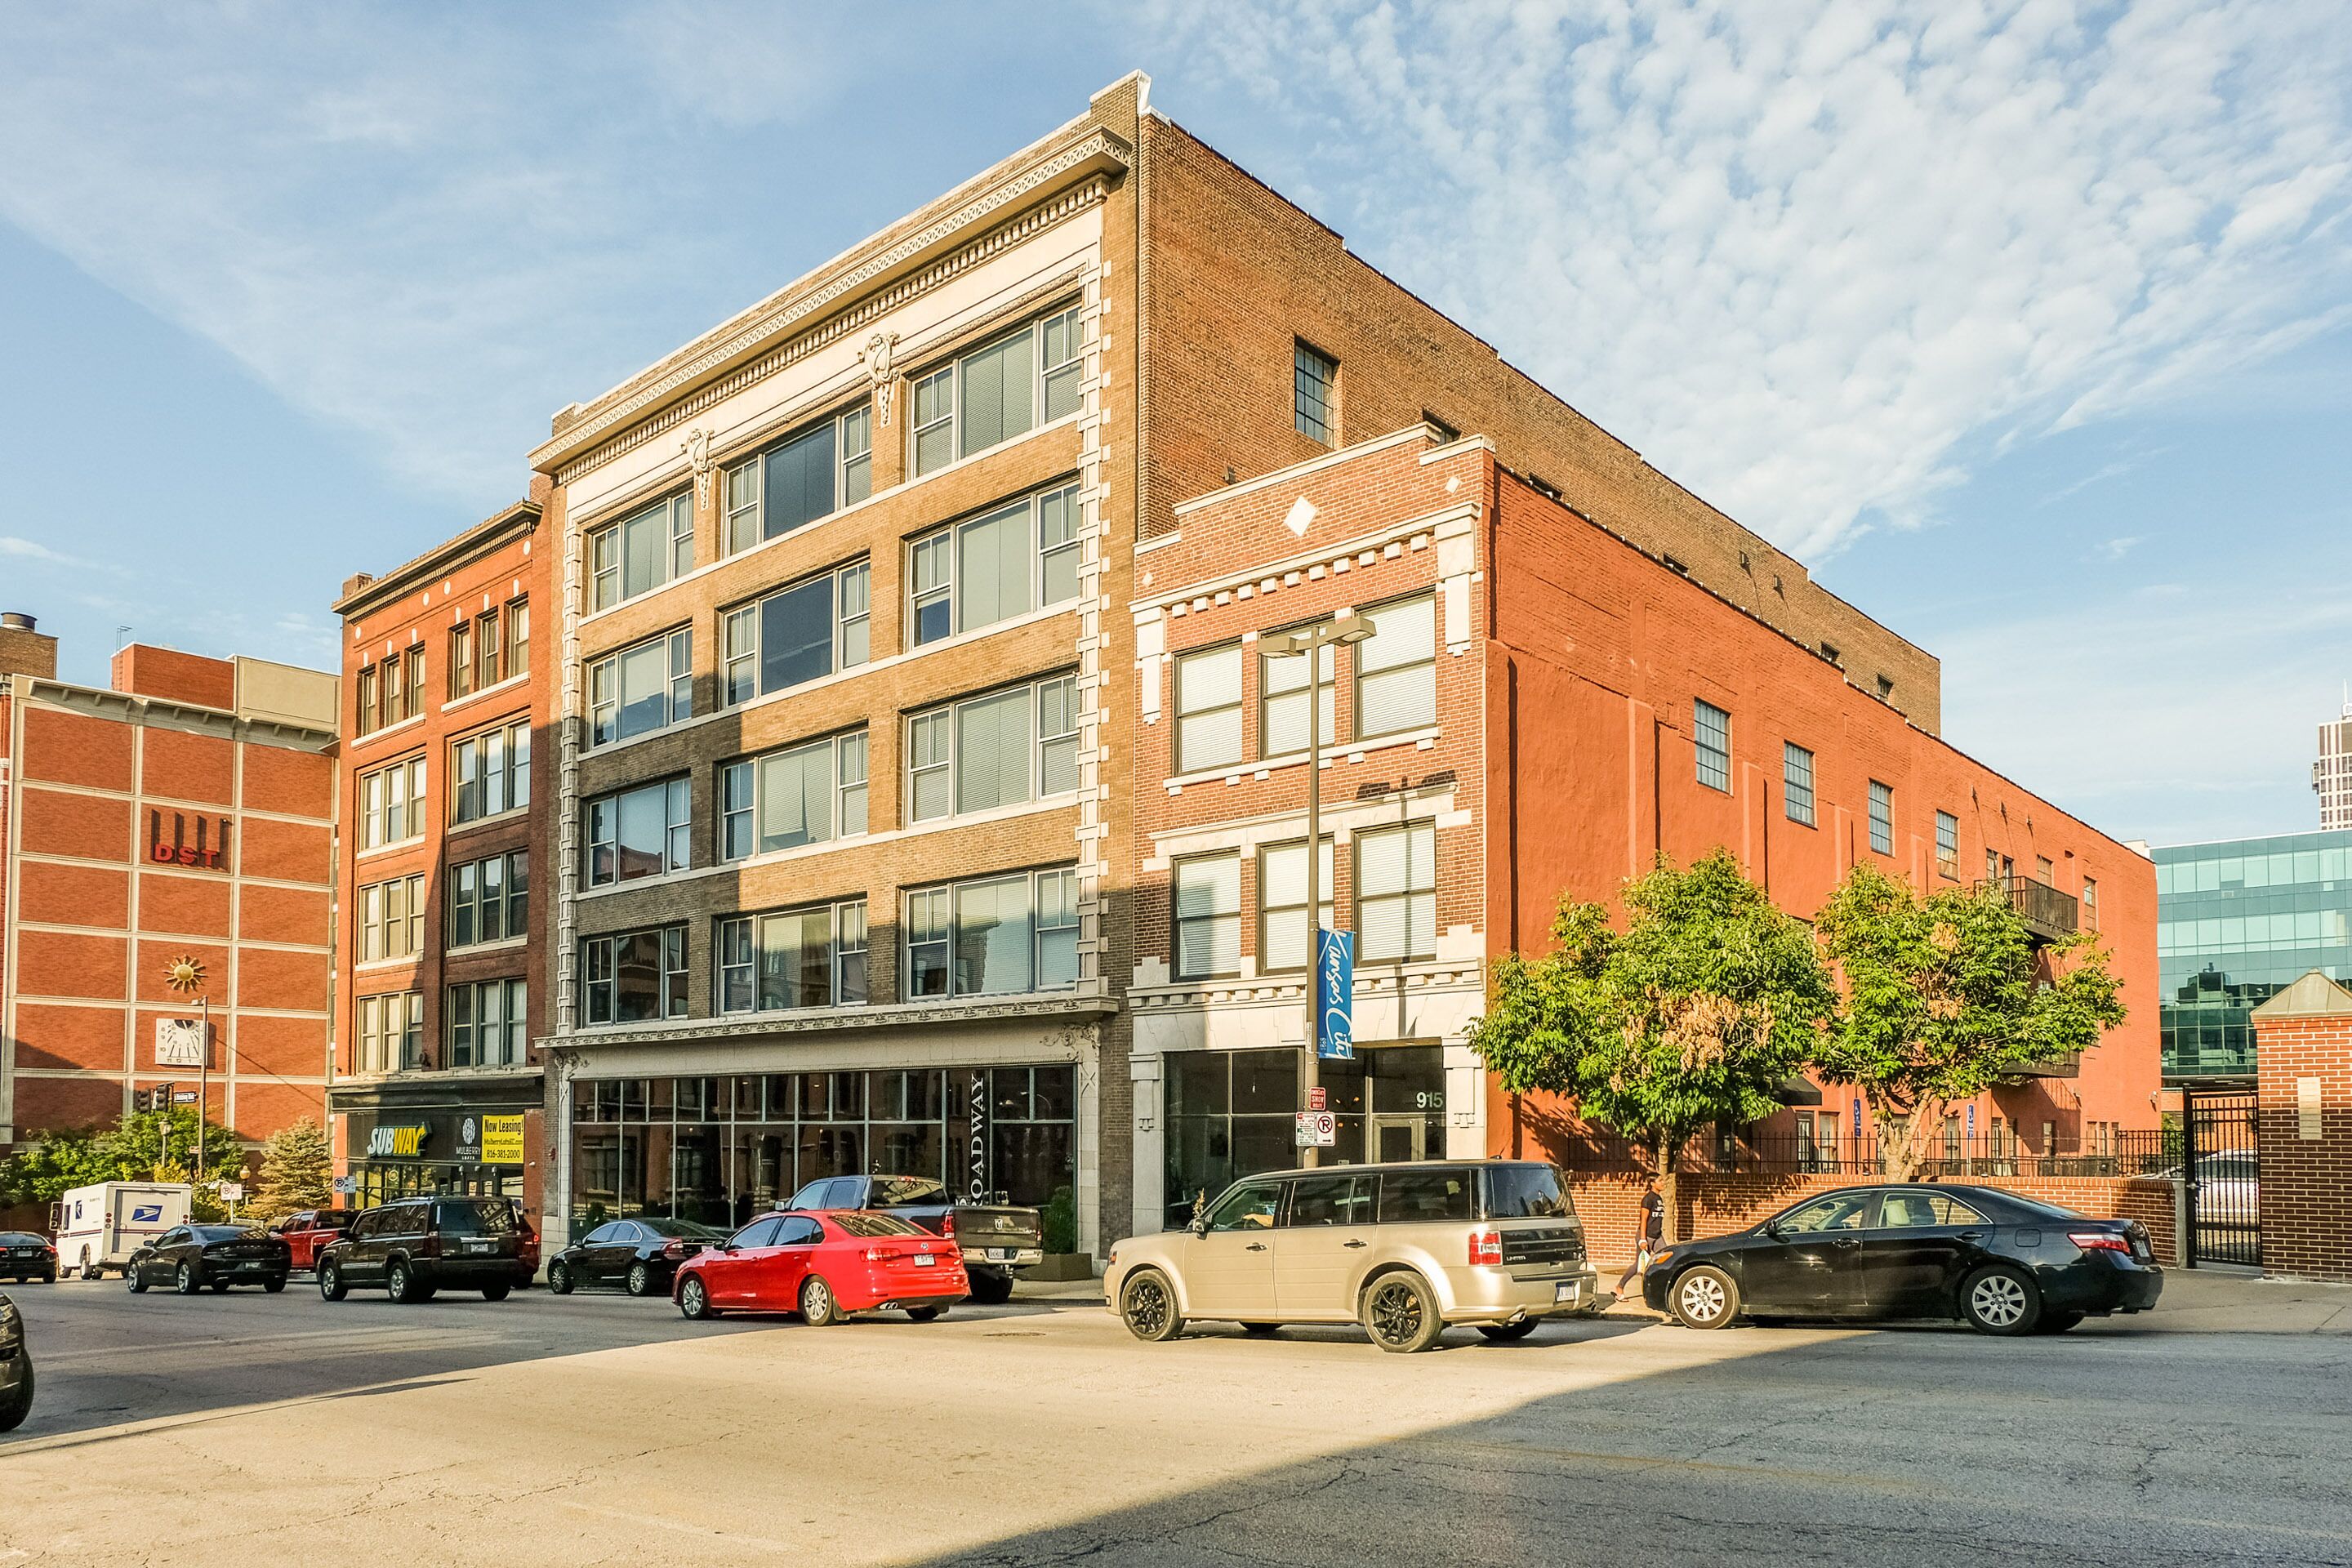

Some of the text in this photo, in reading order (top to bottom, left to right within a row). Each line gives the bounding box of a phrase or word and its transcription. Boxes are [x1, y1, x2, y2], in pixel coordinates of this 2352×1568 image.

[155, 844, 217, 866] DST
[1318, 927, 1354, 1060] Kansas City
[1416, 1091, 1443, 1109] 915
[484, 1119, 523, 1136] Now Leasing!
[367, 1125, 426, 1155] SUBWAY
[456, 1146, 481, 1155] MULBERRY
[486, 1149, 521, 1159] 816-381-2000
